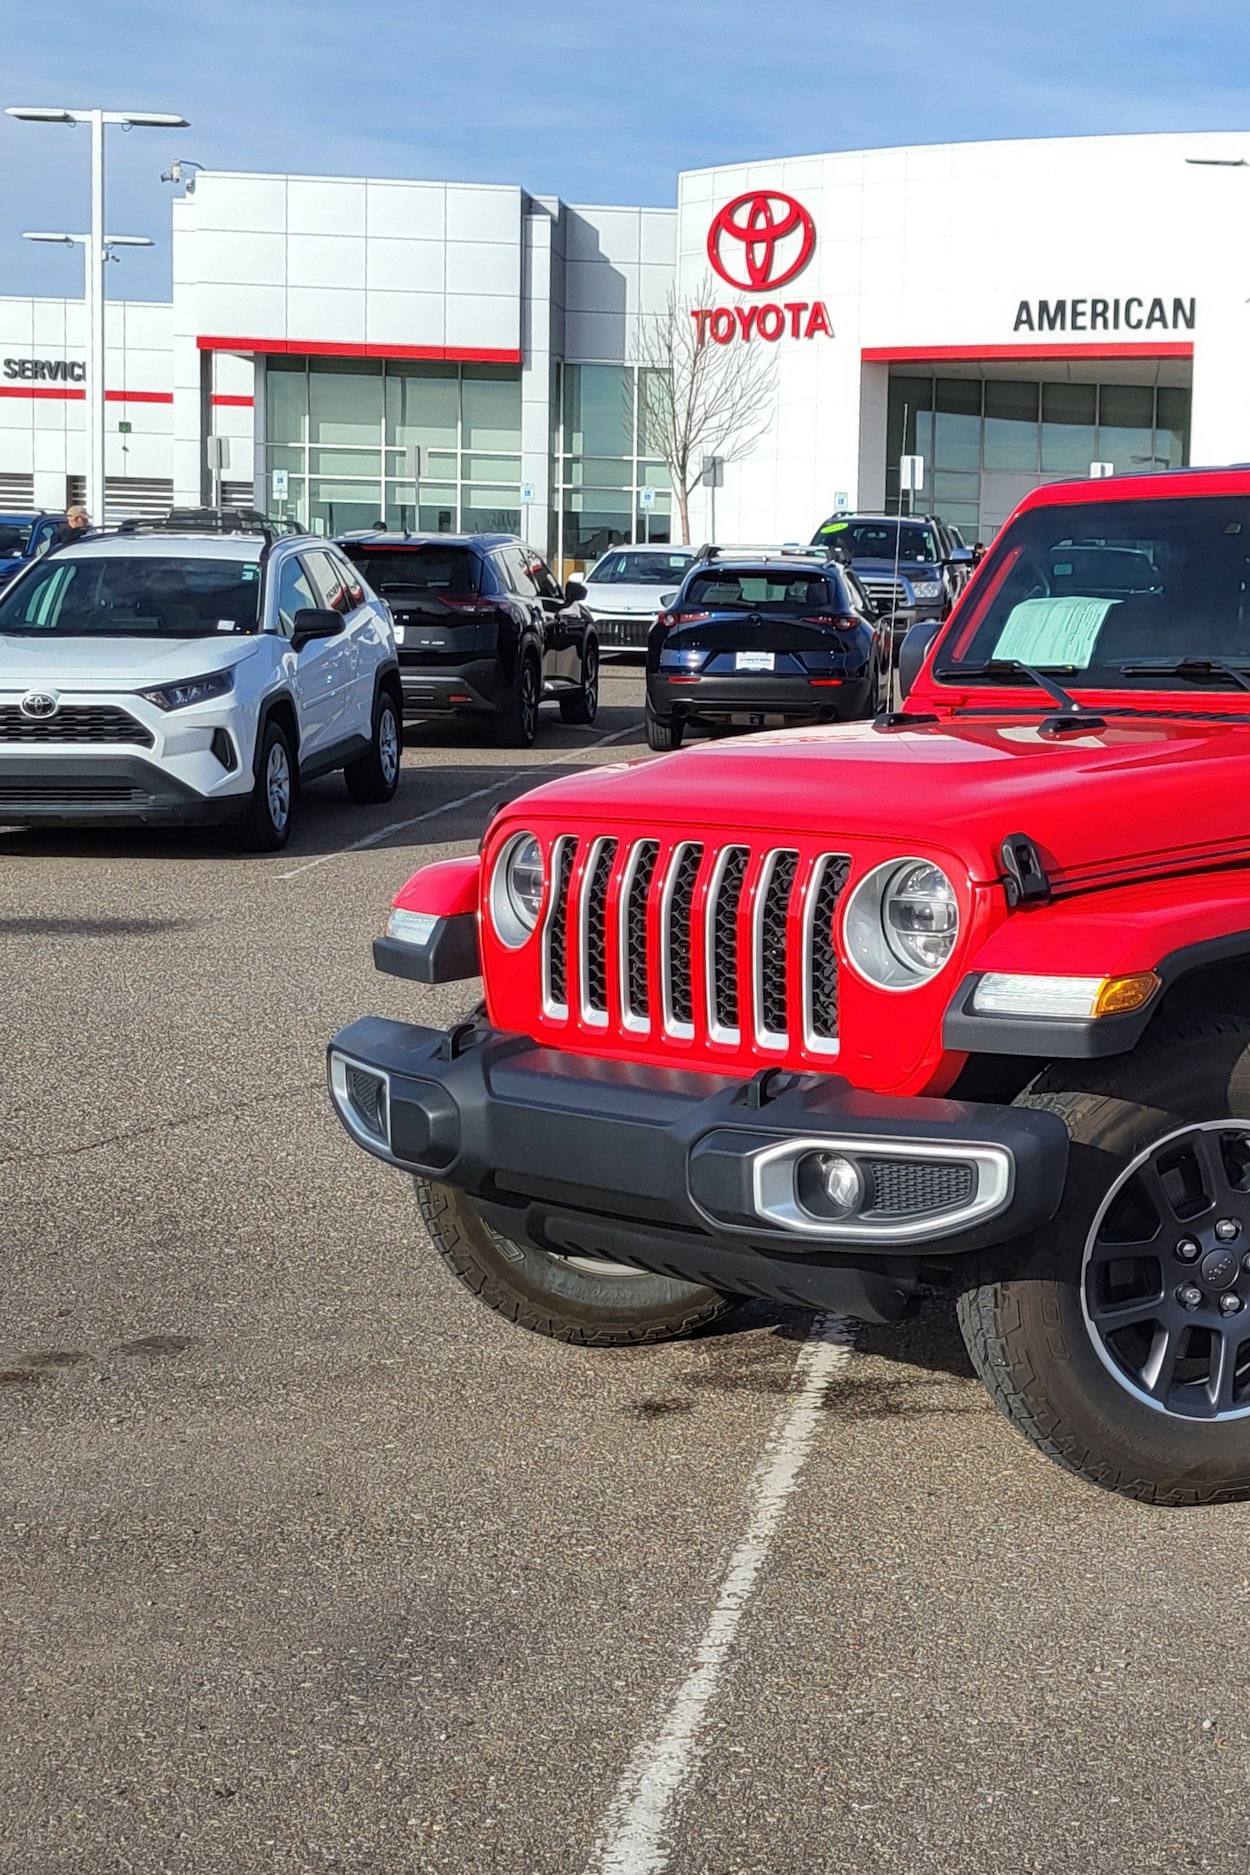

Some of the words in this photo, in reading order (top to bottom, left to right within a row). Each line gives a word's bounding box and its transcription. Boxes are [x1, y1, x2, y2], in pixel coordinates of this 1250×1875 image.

[691, 301, 835, 347] TOYOTA
[1013, 297, 1196, 331] AMERICAN
[3, 358, 86, 382] SERVIC
